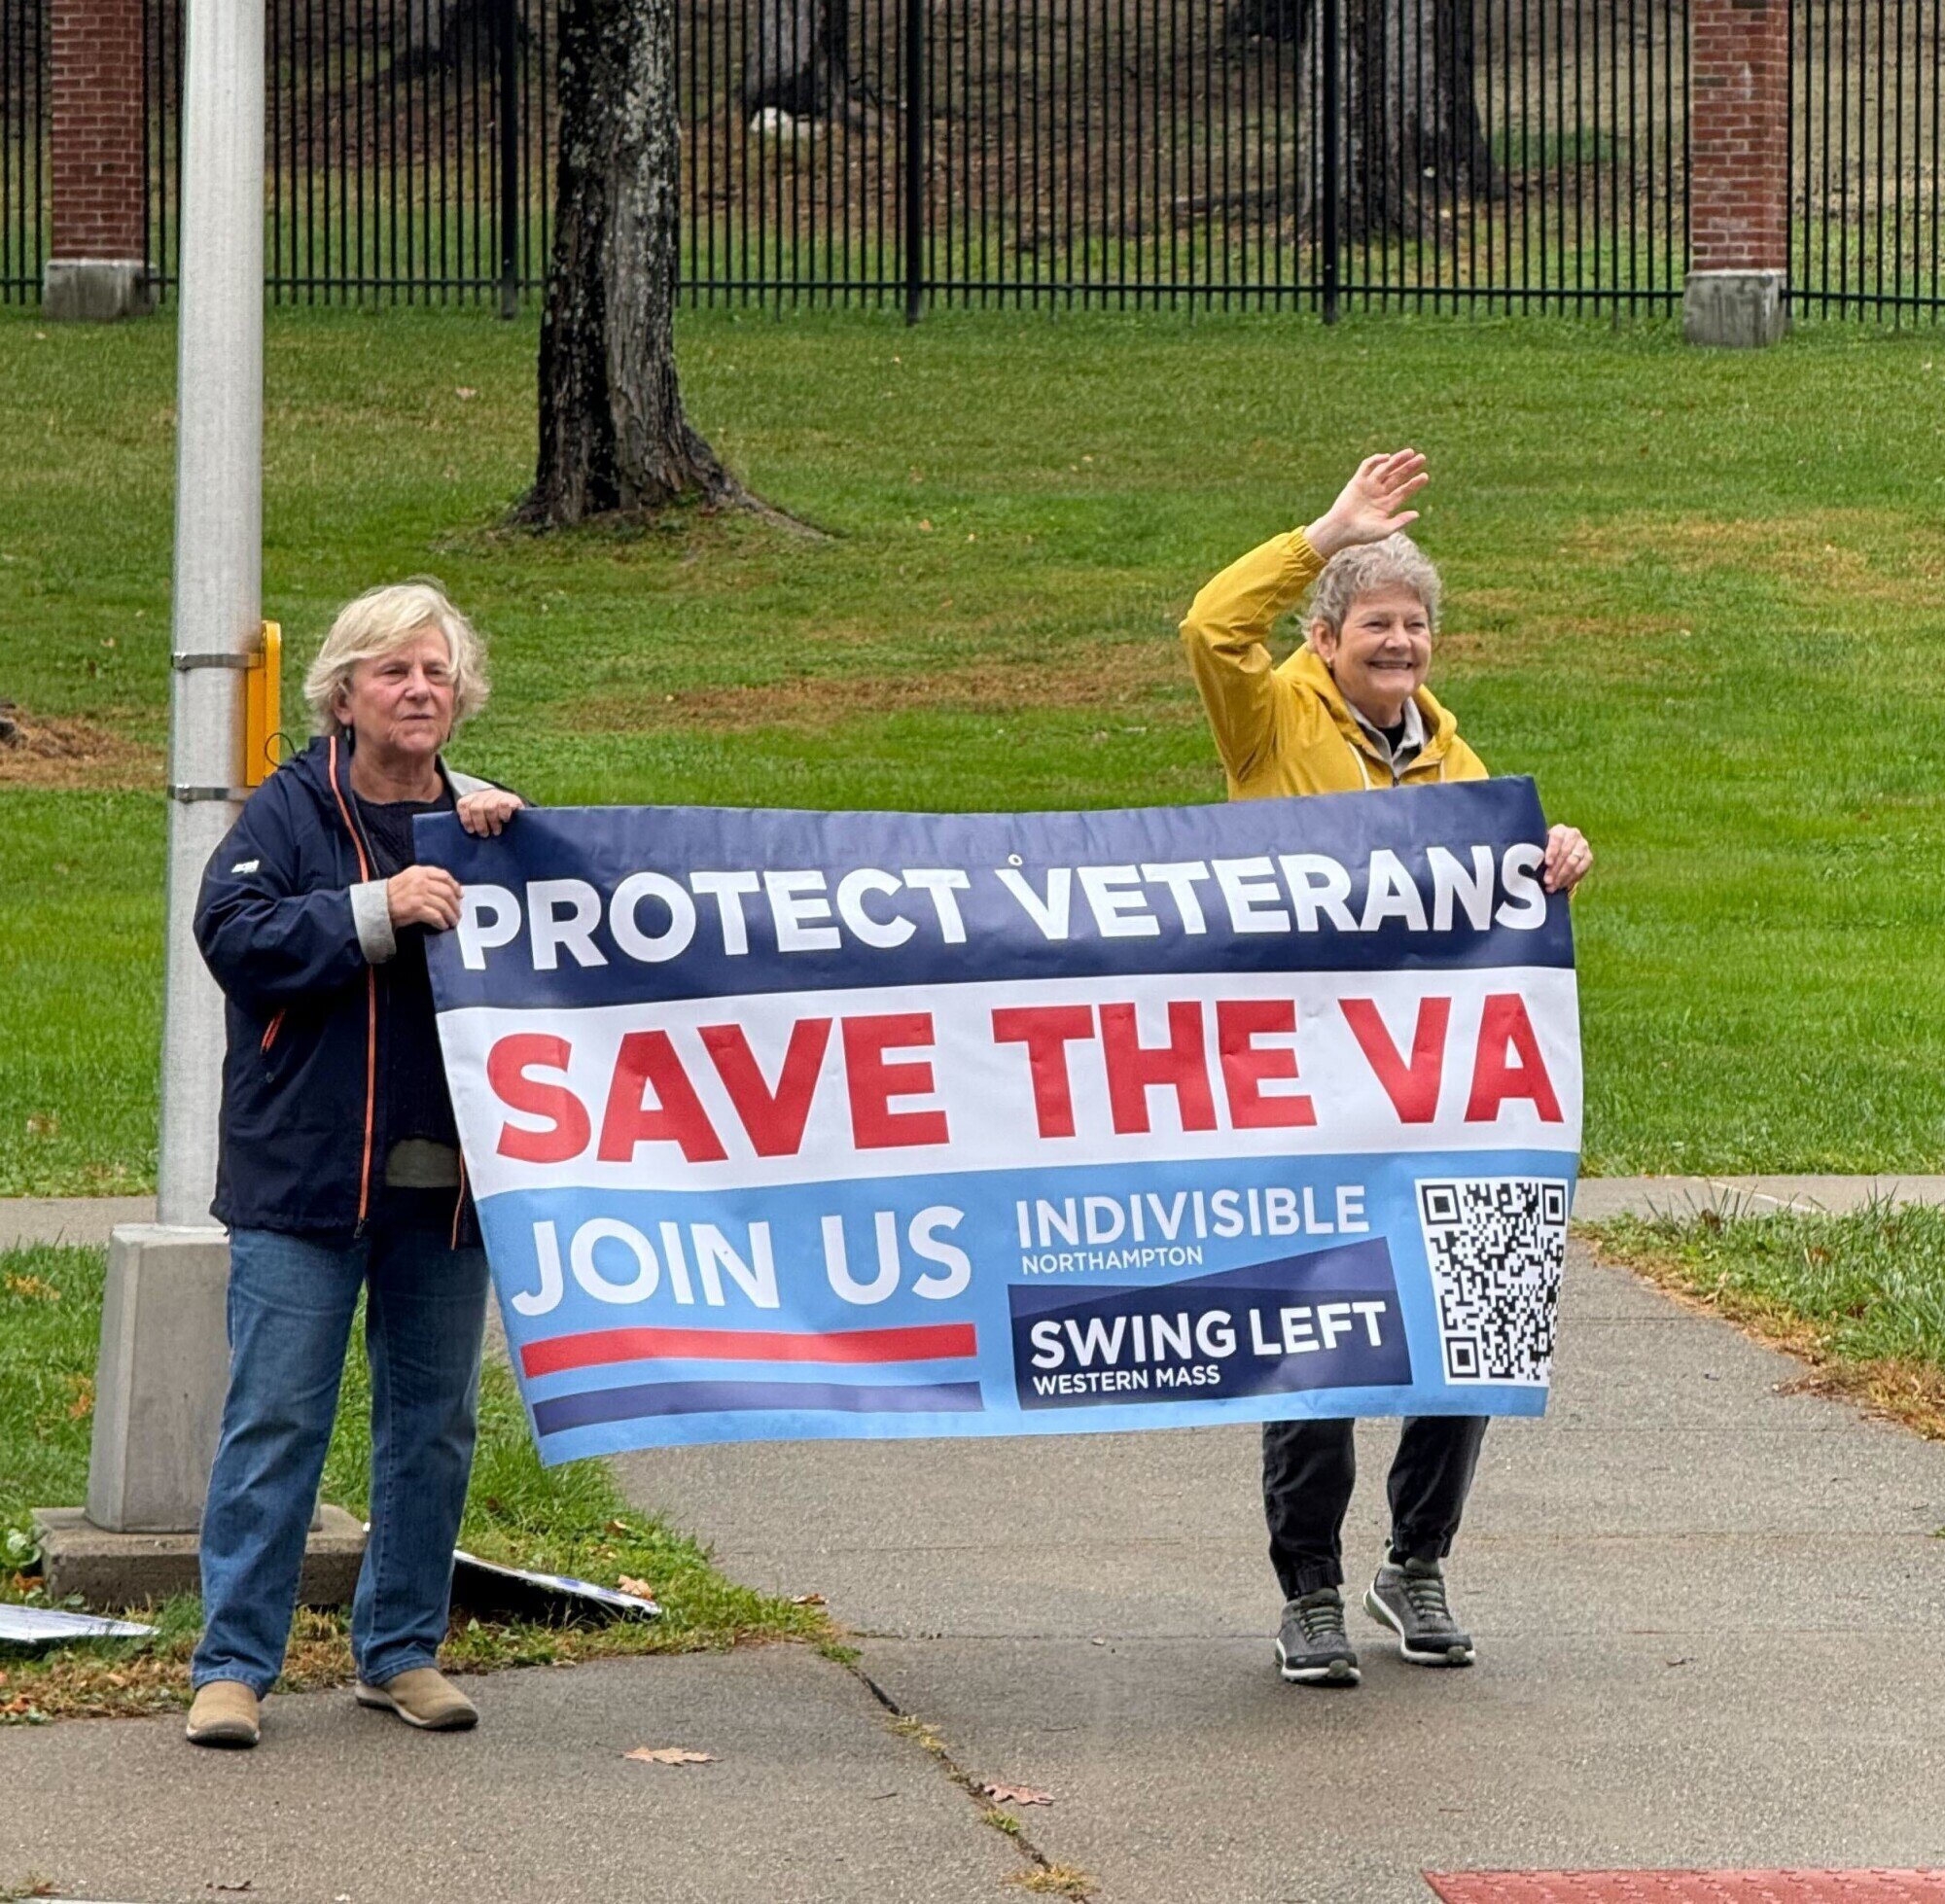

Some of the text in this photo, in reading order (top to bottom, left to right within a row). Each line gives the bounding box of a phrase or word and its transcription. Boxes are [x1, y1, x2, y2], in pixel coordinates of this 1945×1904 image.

[456, 842, 1547, 970] PROTECT VETERANS
[486, 993, 1564, 1164] SAVE THE VA
[1016, 1184, 1369, 1249] INDIVISIBLE
[512, 1205, 972, 1317] JOIN US
[1022, 1246, 1203, 1276] NORTHAMPTON
[1030, 1300, 1387, 1369] SWING LEFT
[1033, 1363, 1221, 1395] WESTERN MASS
